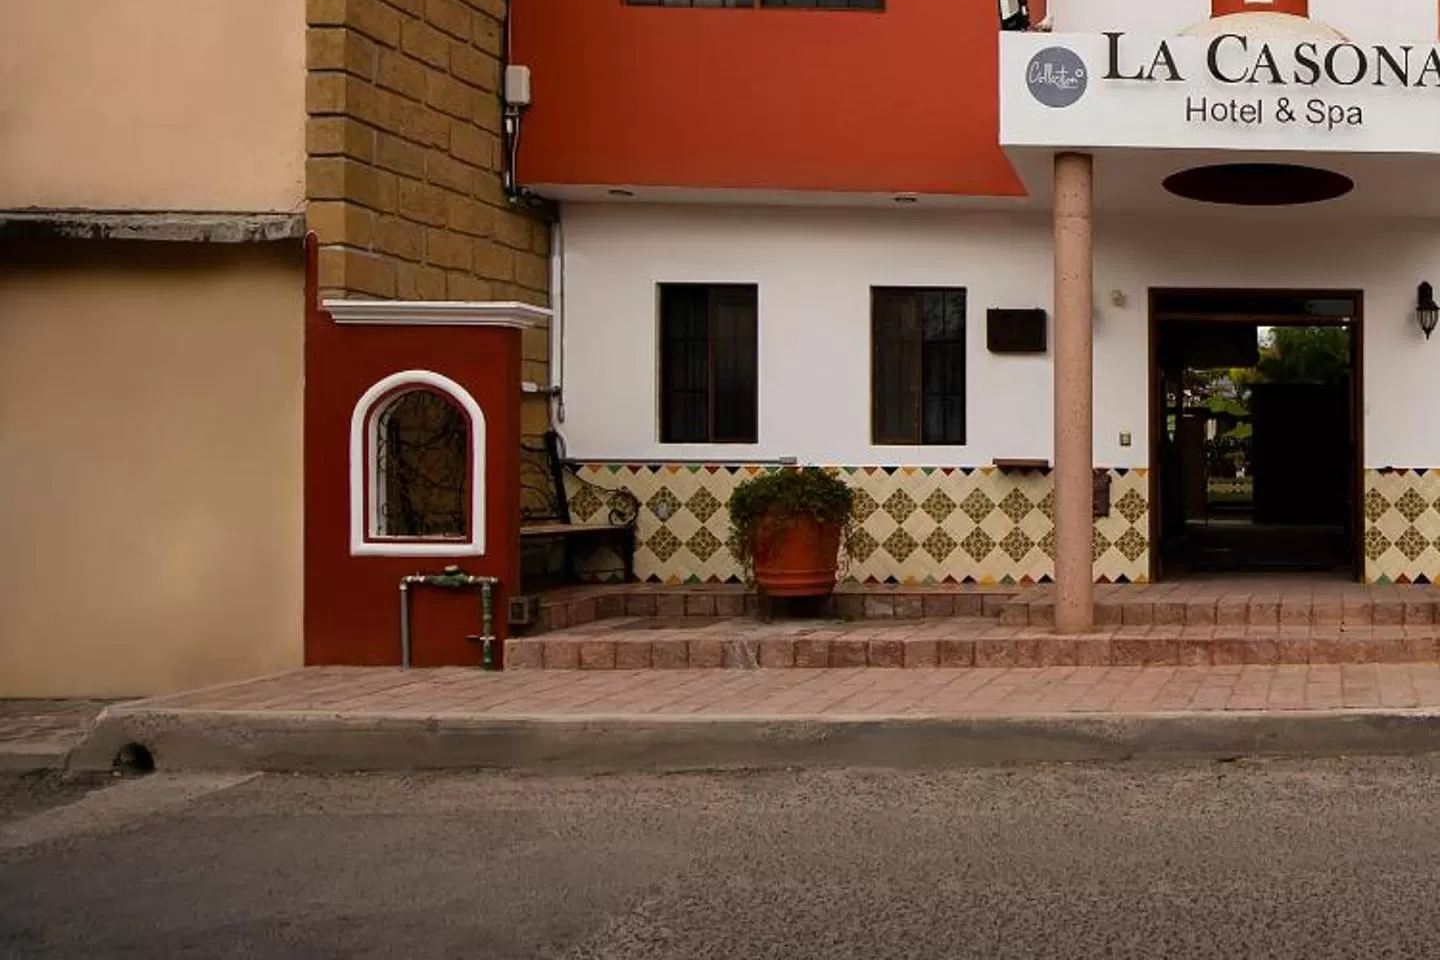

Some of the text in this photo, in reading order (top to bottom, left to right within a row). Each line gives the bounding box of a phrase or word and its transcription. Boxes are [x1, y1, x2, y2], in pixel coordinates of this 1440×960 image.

[1101, 31, 1186, 81] LA
[1186, 96, 1364, 131] Hotel & Spa
